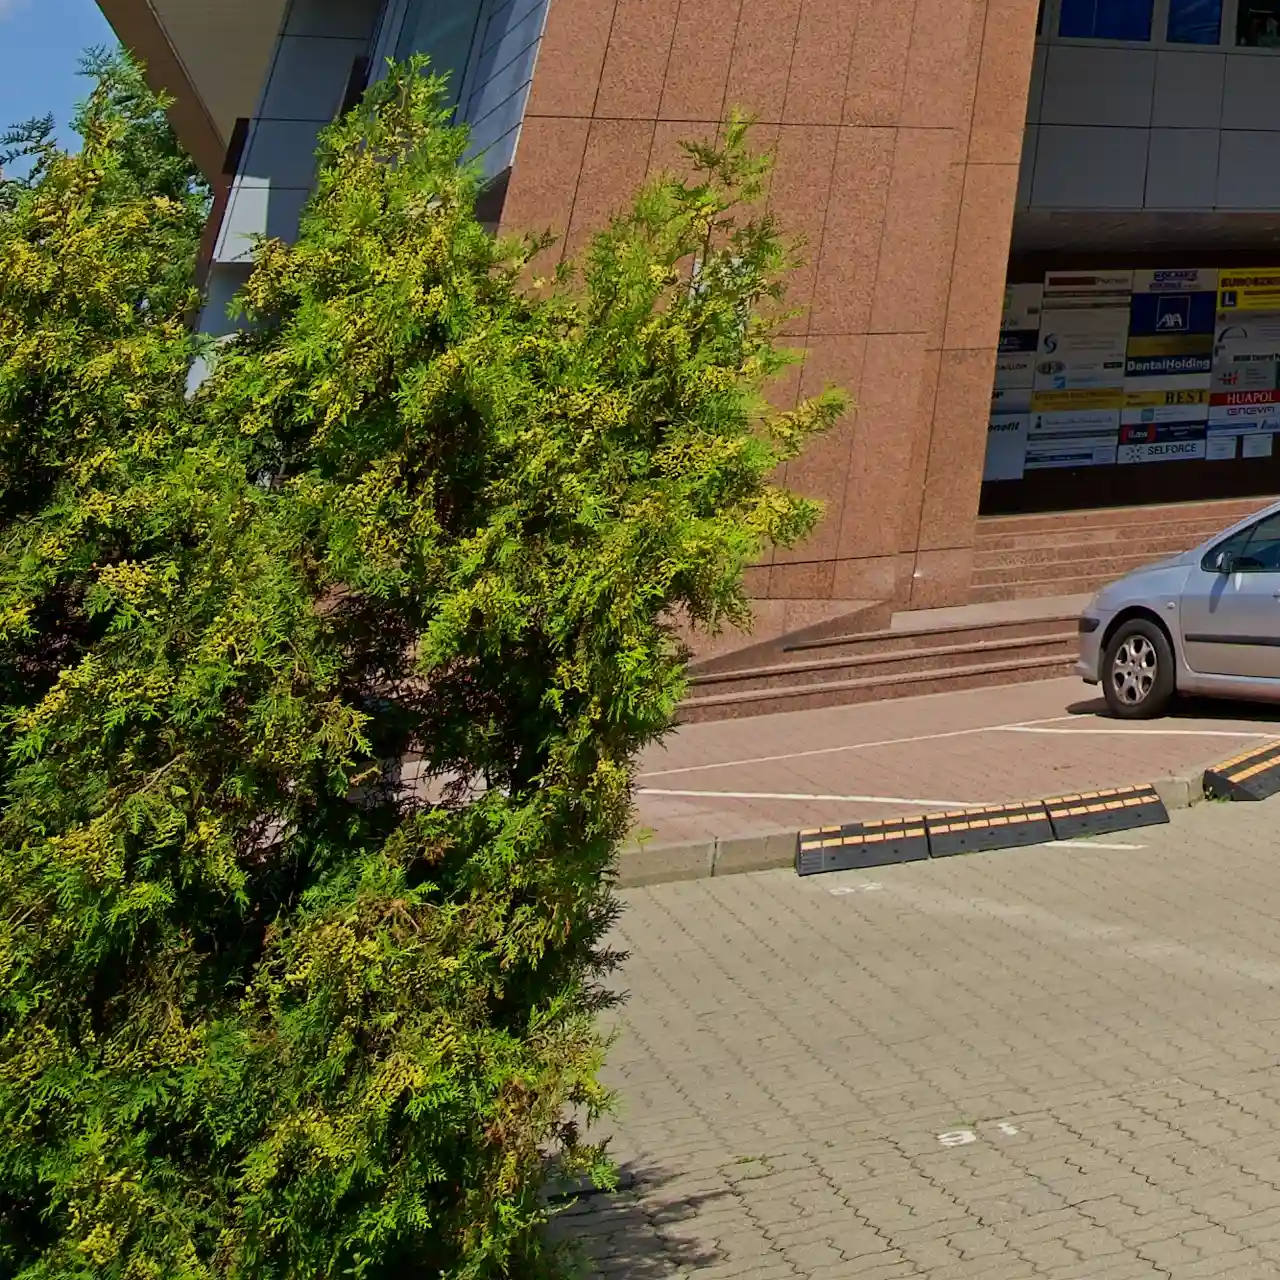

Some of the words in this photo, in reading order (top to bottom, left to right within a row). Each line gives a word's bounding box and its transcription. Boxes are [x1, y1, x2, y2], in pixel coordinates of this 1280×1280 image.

[1156, 312, 1183, 329] AXA
[1127, 357, 1210, 372] DentalHolding
[1165, 391, 1206, 404] BEST
[1227, 392, 1275, 404] HUAPOL
[1147, 443, 1197, 455] SELFORCE
